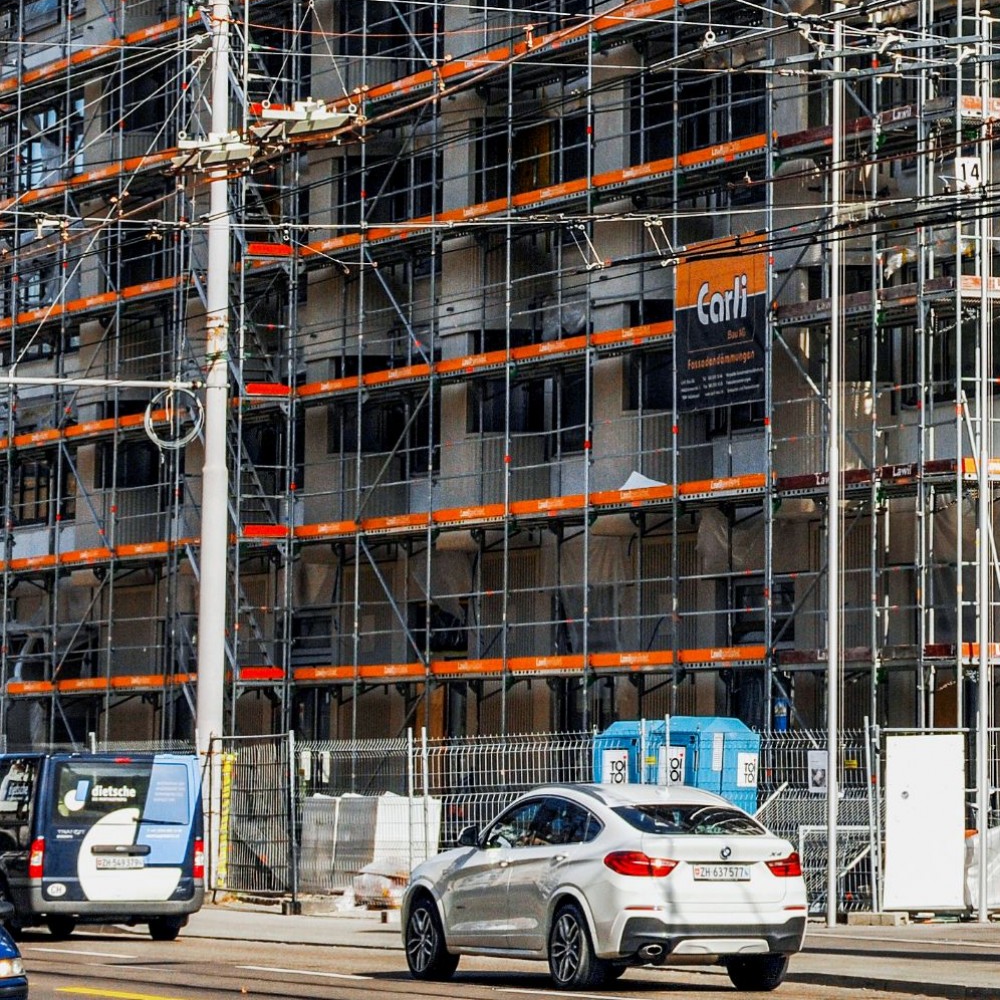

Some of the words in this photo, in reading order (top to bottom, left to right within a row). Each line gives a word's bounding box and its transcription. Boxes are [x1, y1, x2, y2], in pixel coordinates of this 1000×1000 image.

[961, 163, 979, 180] 14
[697, 274, 748, 326] Carli
[91, 785, 137, 798] dietsche
[700, 866, 711, 877] ZH
[713, 866, 744, 878] 637577
[50, 885, 63, 894] CH
